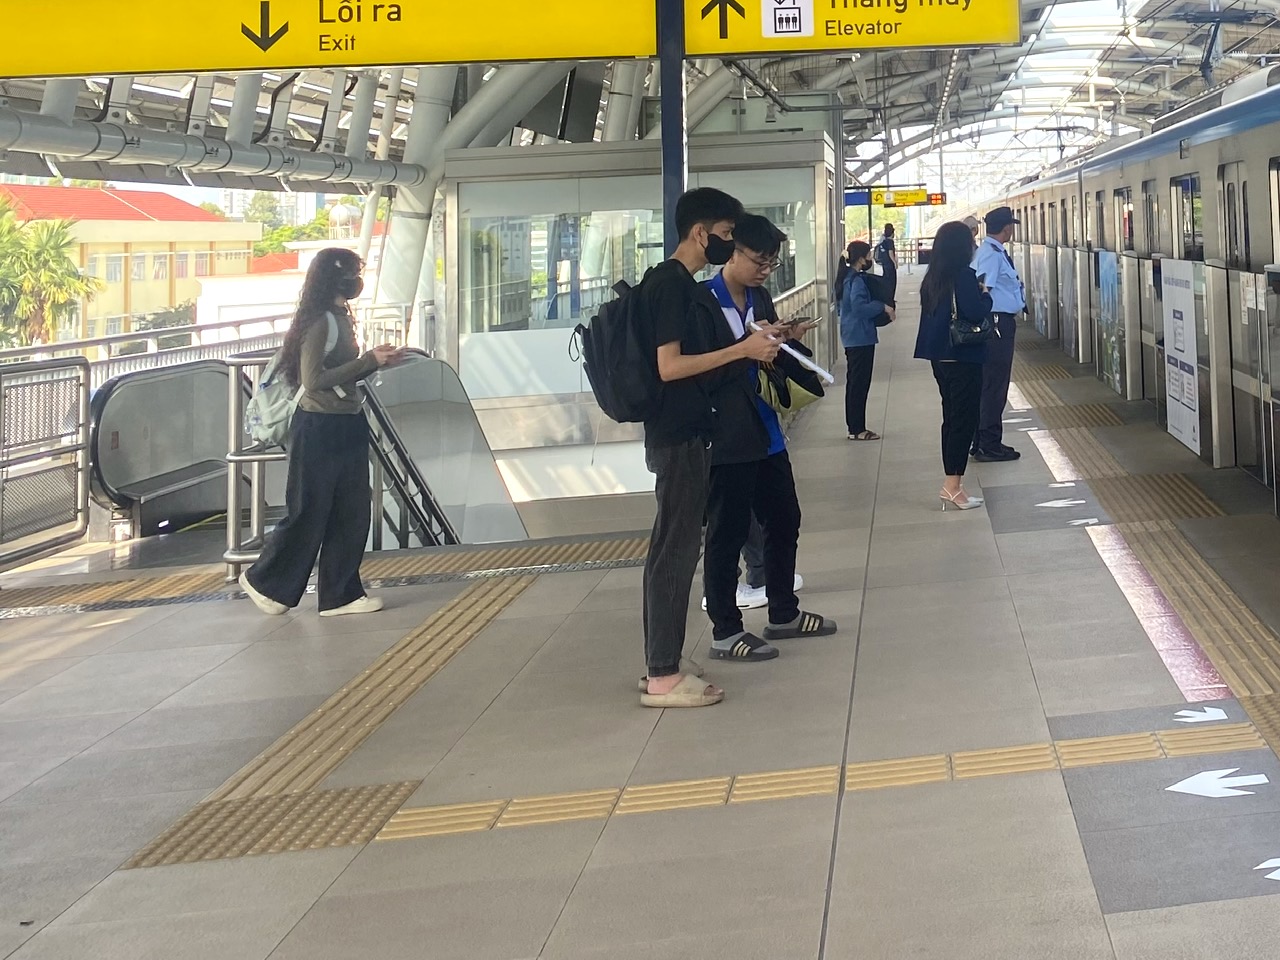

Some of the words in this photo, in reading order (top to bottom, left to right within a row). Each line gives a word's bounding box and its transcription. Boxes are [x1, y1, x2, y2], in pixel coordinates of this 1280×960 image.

[373, 3, 402, 22] ra
[825, 19, 902, 36] Elevator
[318, 34, 356, 51] Exit
